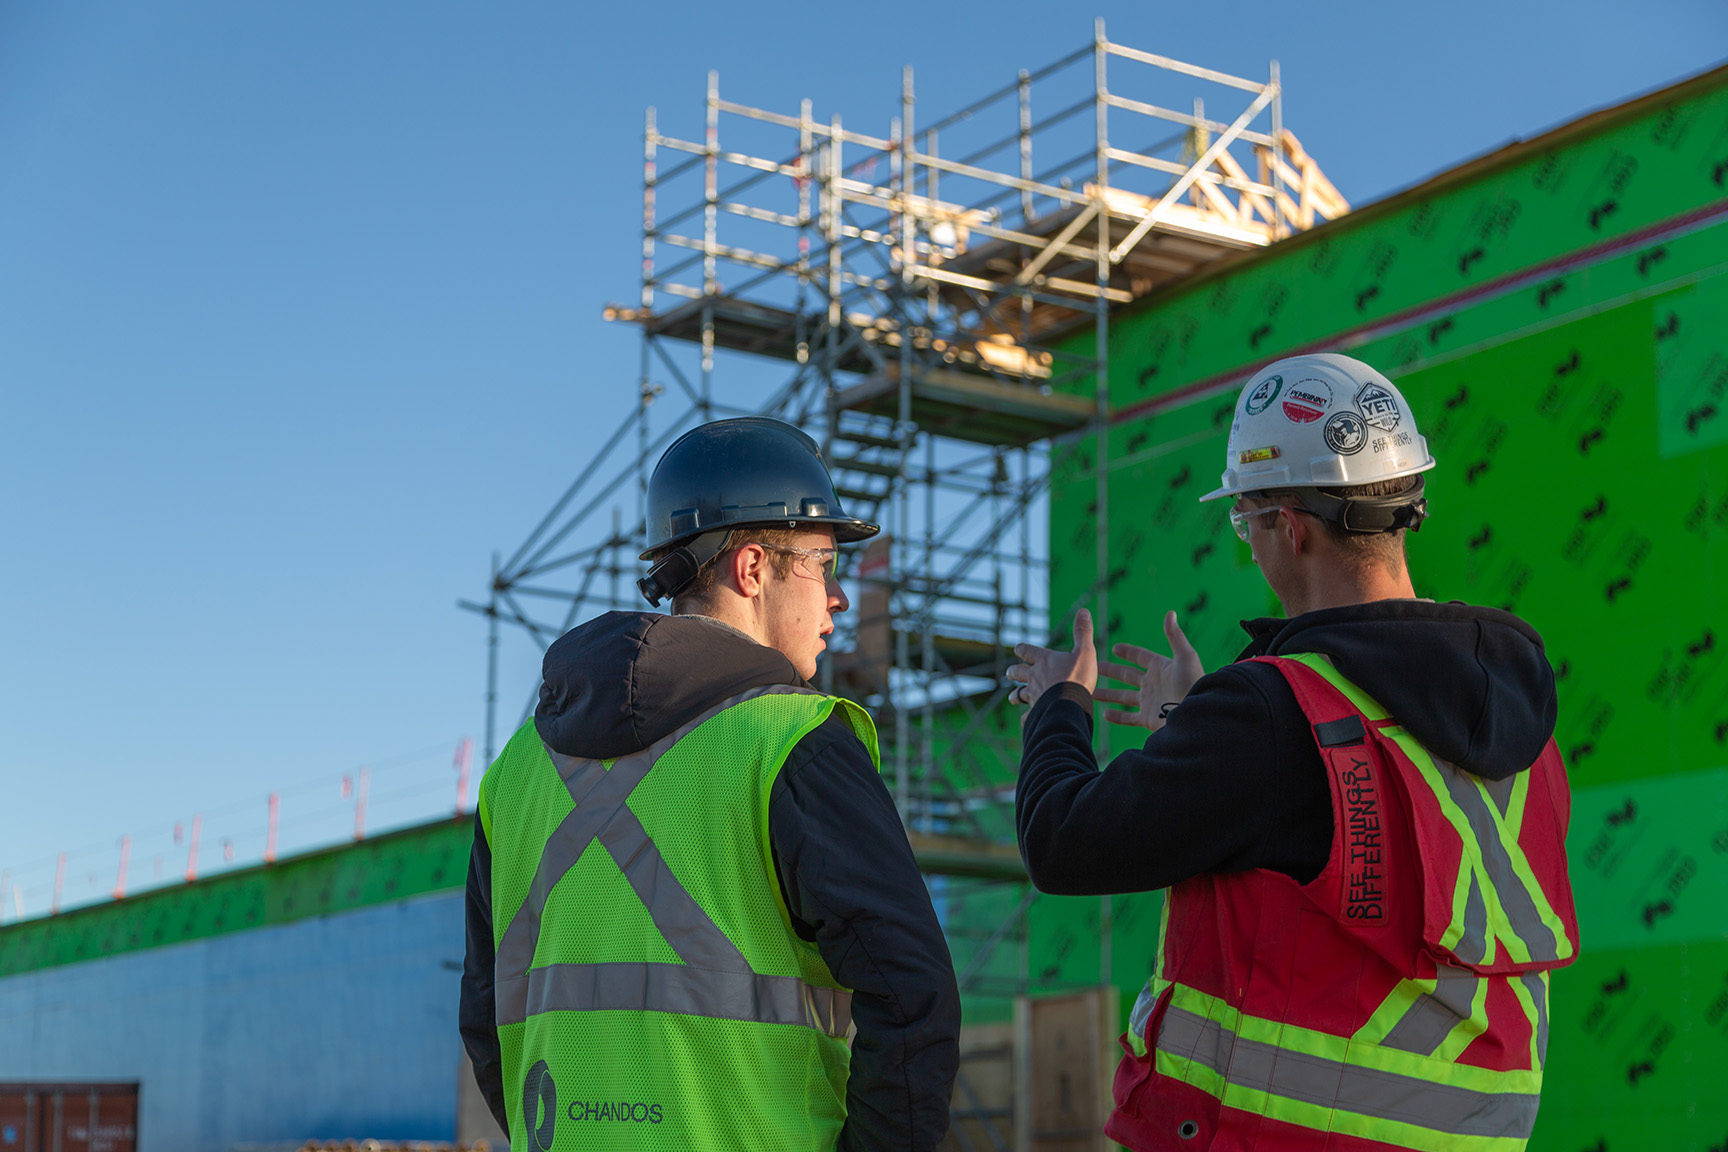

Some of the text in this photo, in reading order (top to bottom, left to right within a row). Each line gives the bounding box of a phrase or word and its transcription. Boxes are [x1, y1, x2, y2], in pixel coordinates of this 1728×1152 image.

[1362, 399, 1395, 416] YETI
[1372, 432, 1408, 446] SEE THINGS
[1342, 771, 1366, 919] SEE THINGS
[1350, 758, 1382, 918] DIFFERENTLY
[568, 1101, 663, 1124] CHANDOS
